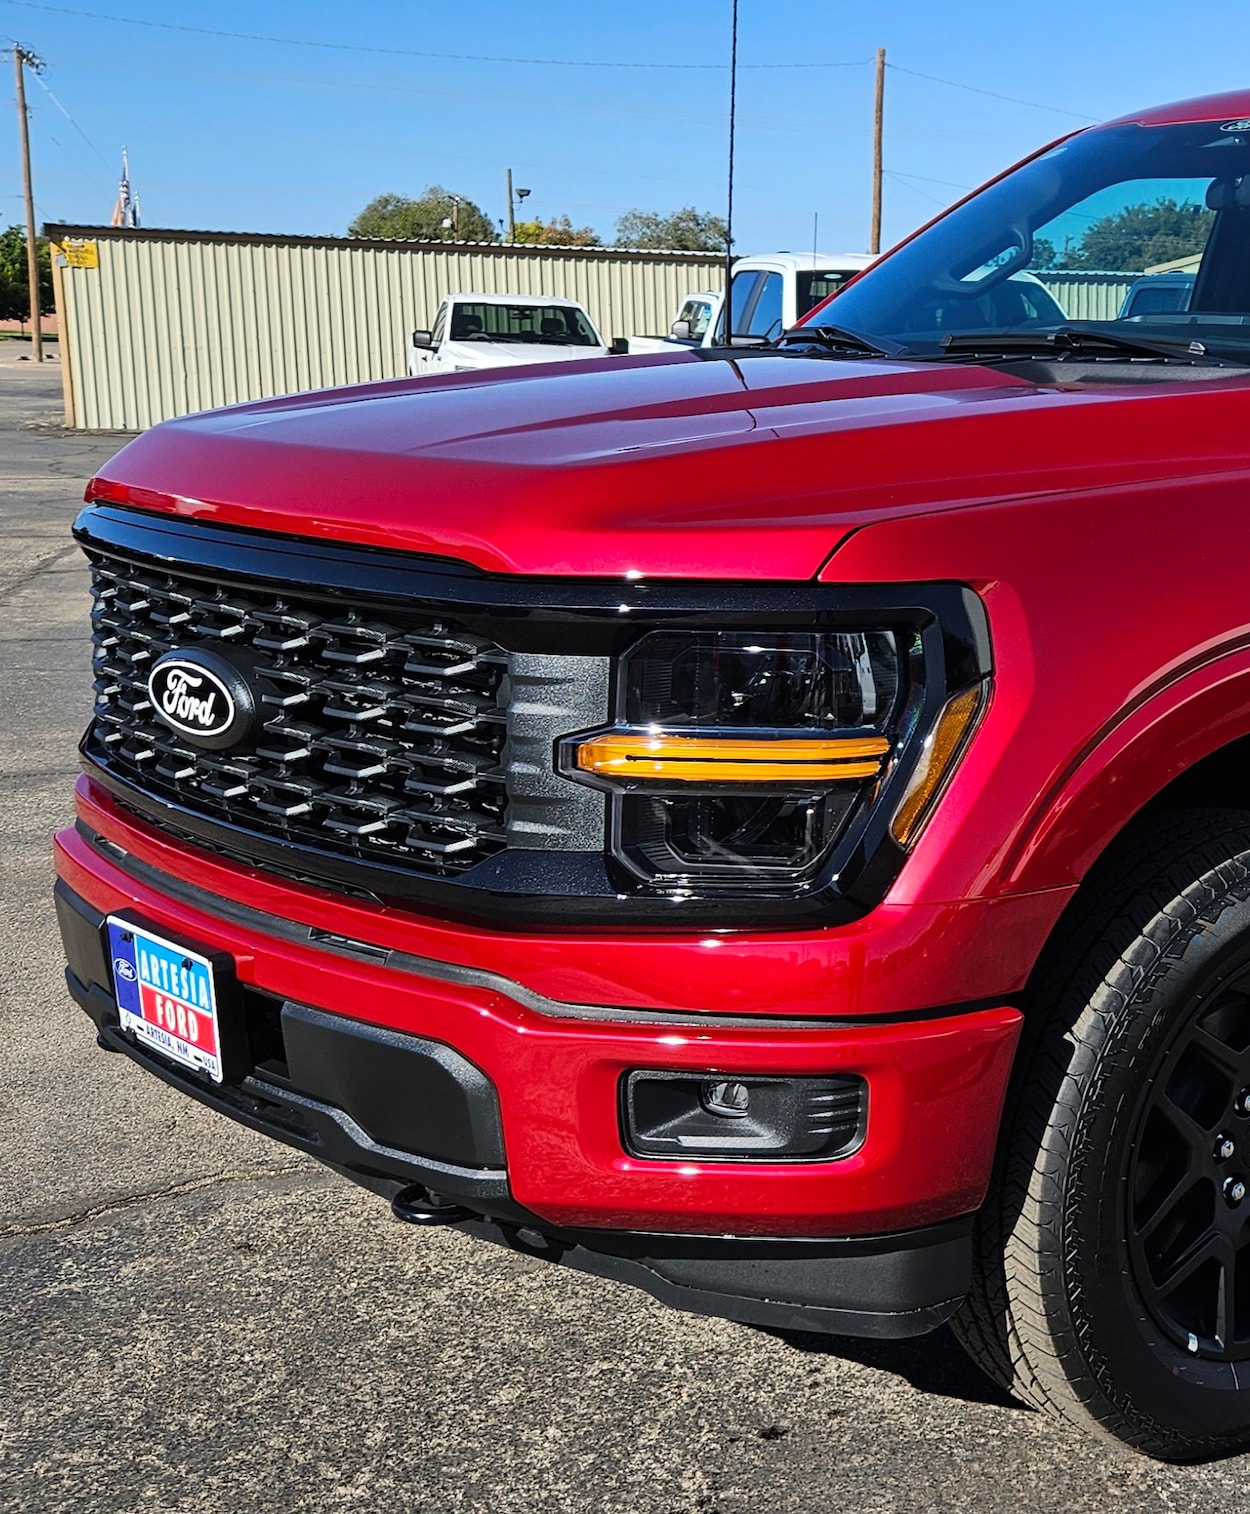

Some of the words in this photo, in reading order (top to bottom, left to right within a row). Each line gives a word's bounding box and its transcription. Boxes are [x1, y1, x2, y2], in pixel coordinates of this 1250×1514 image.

[162, 668, 217, 727] Ford
[140, 949, 211, 1011] ARTESIA
[155, 994, 199, 1043] FORD
[202, 1055, 217, 1070] USA
